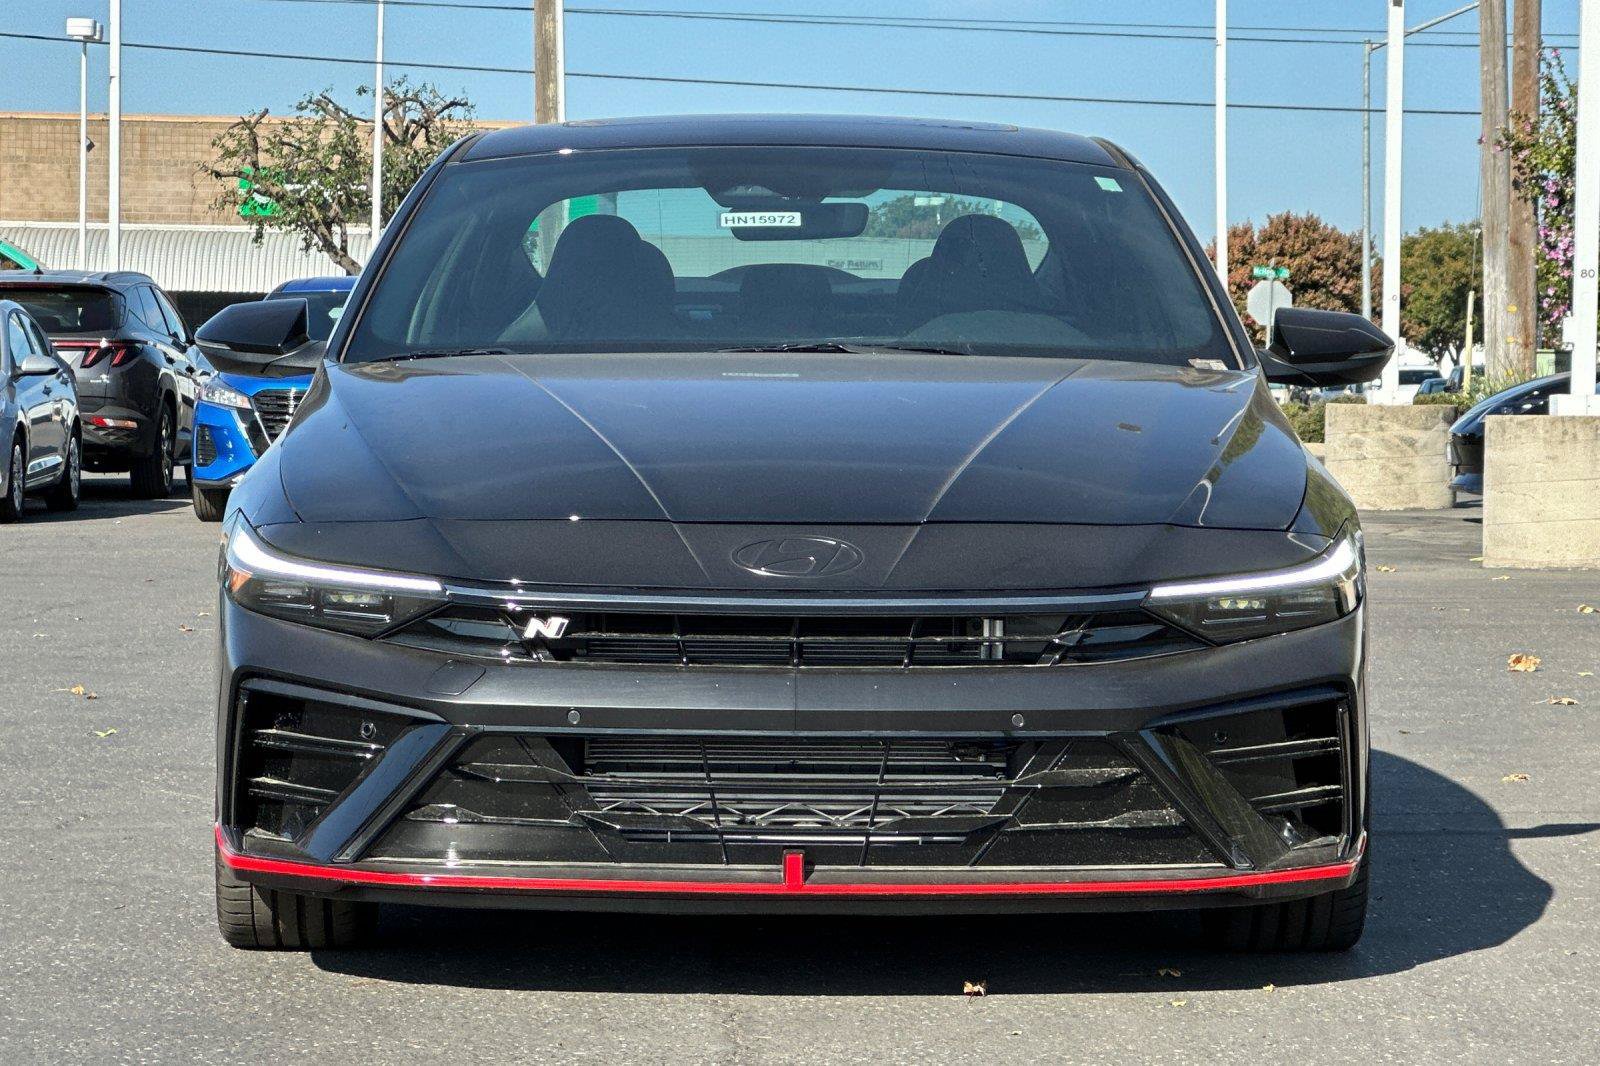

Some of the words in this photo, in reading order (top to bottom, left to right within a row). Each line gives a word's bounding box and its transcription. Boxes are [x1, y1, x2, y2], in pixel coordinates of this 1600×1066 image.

[724, 215, 796, 225] HN15972
[1580, 269, 1595, 278] 80
[522, 616, 569, 639] N
